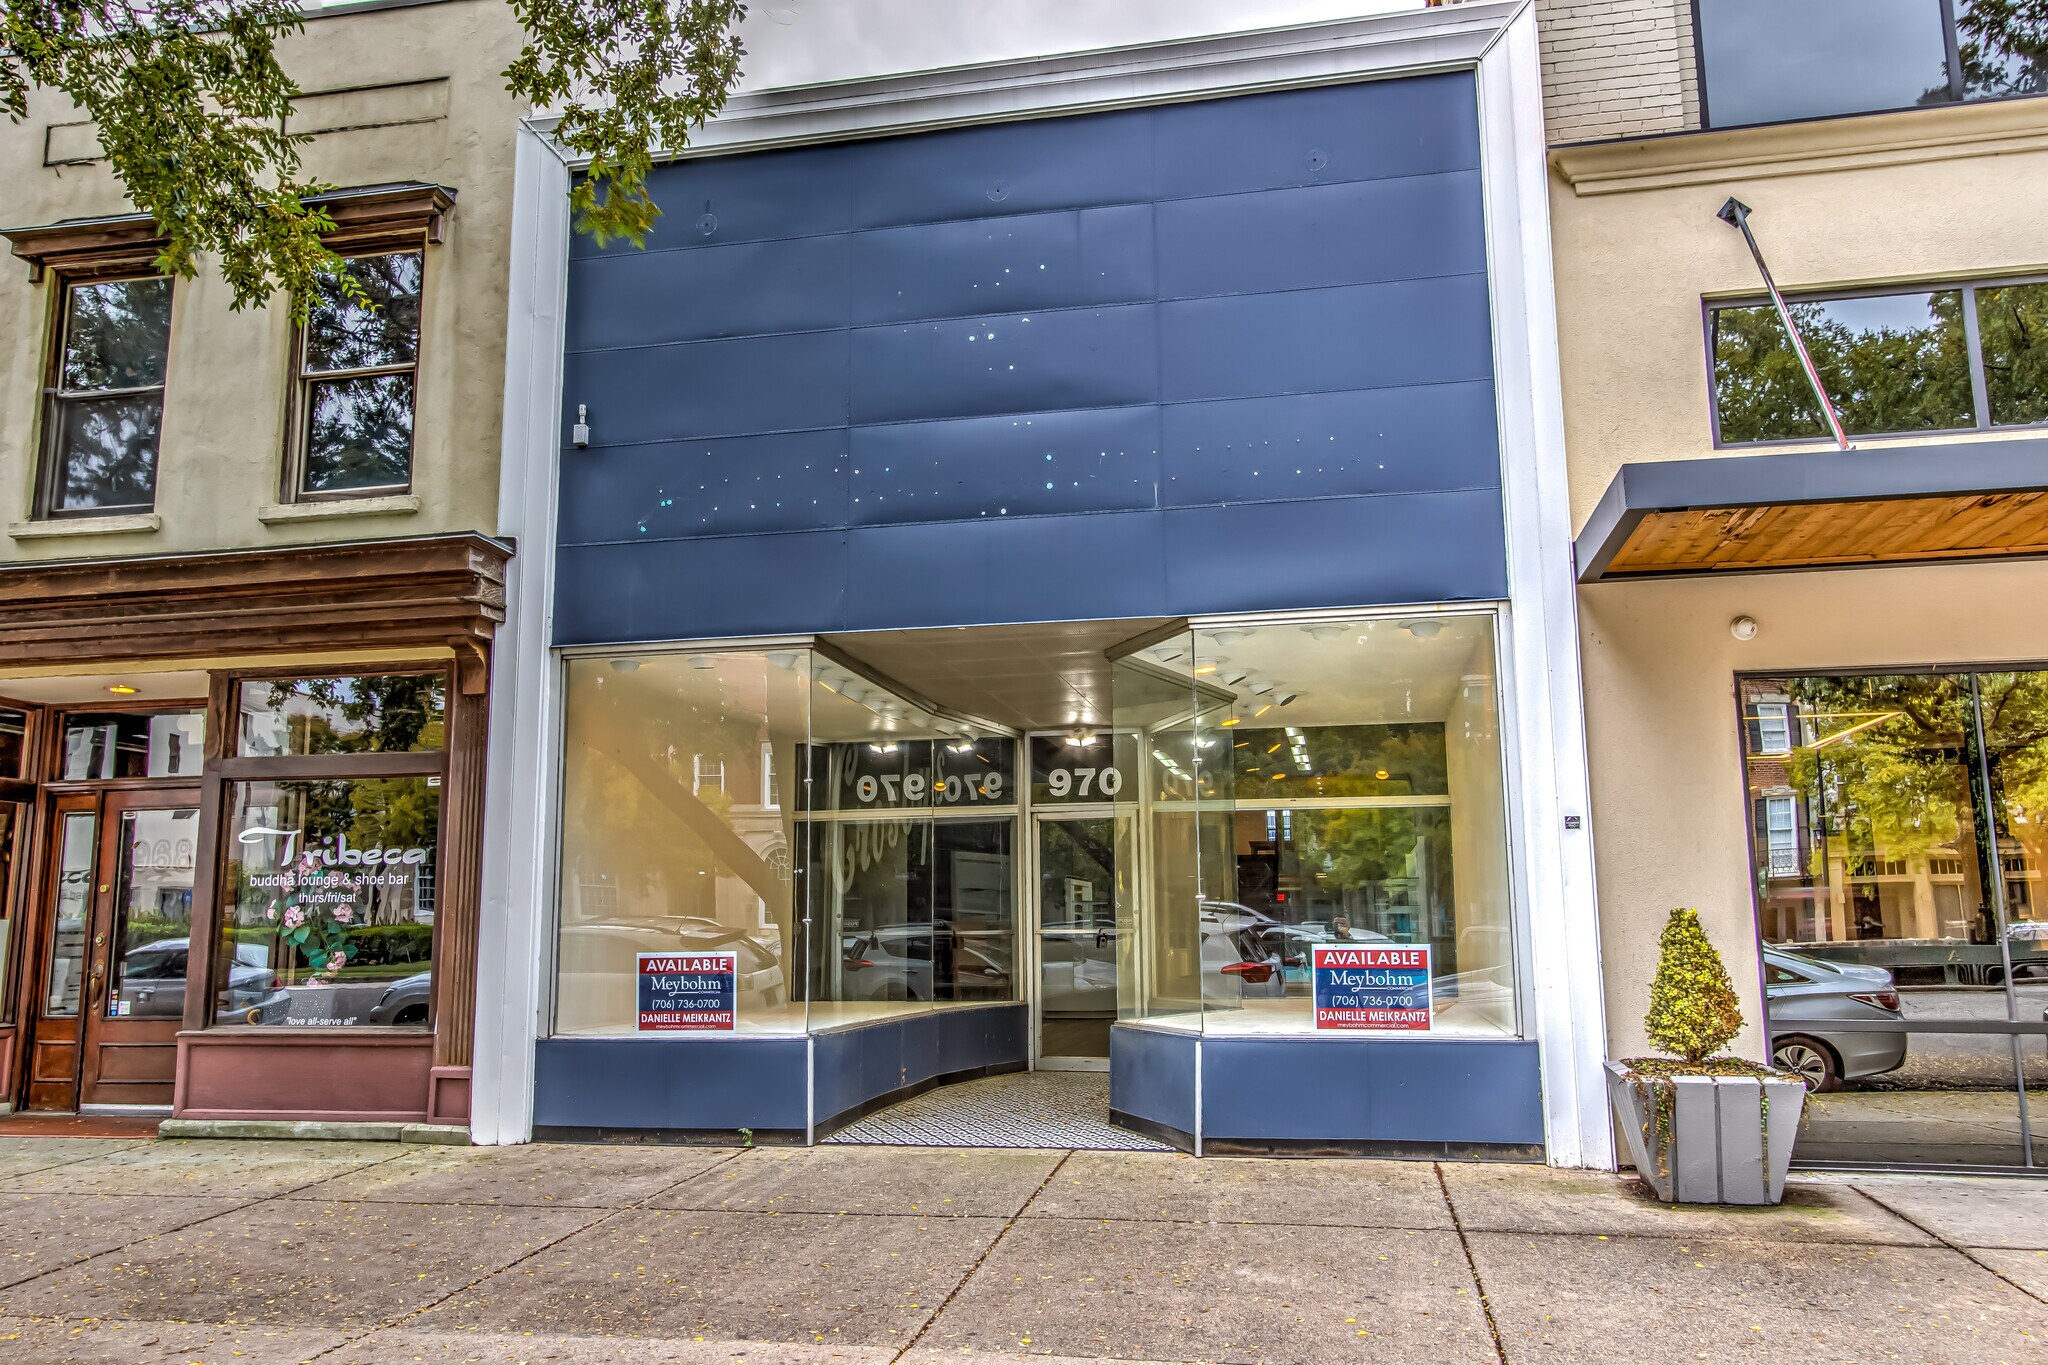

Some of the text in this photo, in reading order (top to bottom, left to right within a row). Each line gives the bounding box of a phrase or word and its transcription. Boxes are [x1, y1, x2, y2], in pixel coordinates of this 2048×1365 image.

[1049, 767, 1123, 796] 970
[238, 827, 427, 866] Tribeca
[133, 838, 193, 873] 968
[250, 872, 409, 888] buddha lounge & shoe bar
[299, 892, 357, 904] thurs/fri/sat
[646, 958, 727, 972] AVAILABLE
[1323, 952, 1420, 965] AVAILABLE
[651, 976, 721, 996] Meybohm
[1330, 970, 1414, 992] Meybohm
[652, 999, 720, 1010] (706) 736-0700
[1332, 996, 1413, 1007] (706) 736-0700
[286, 1017, 357, 1025] "love all-serve all"
[641, 1013, 731, 1023] DANIELLE MEIKRANTZ
[1320, 1011, 1427, 1022] DANIELLE MEIKRANTZ
